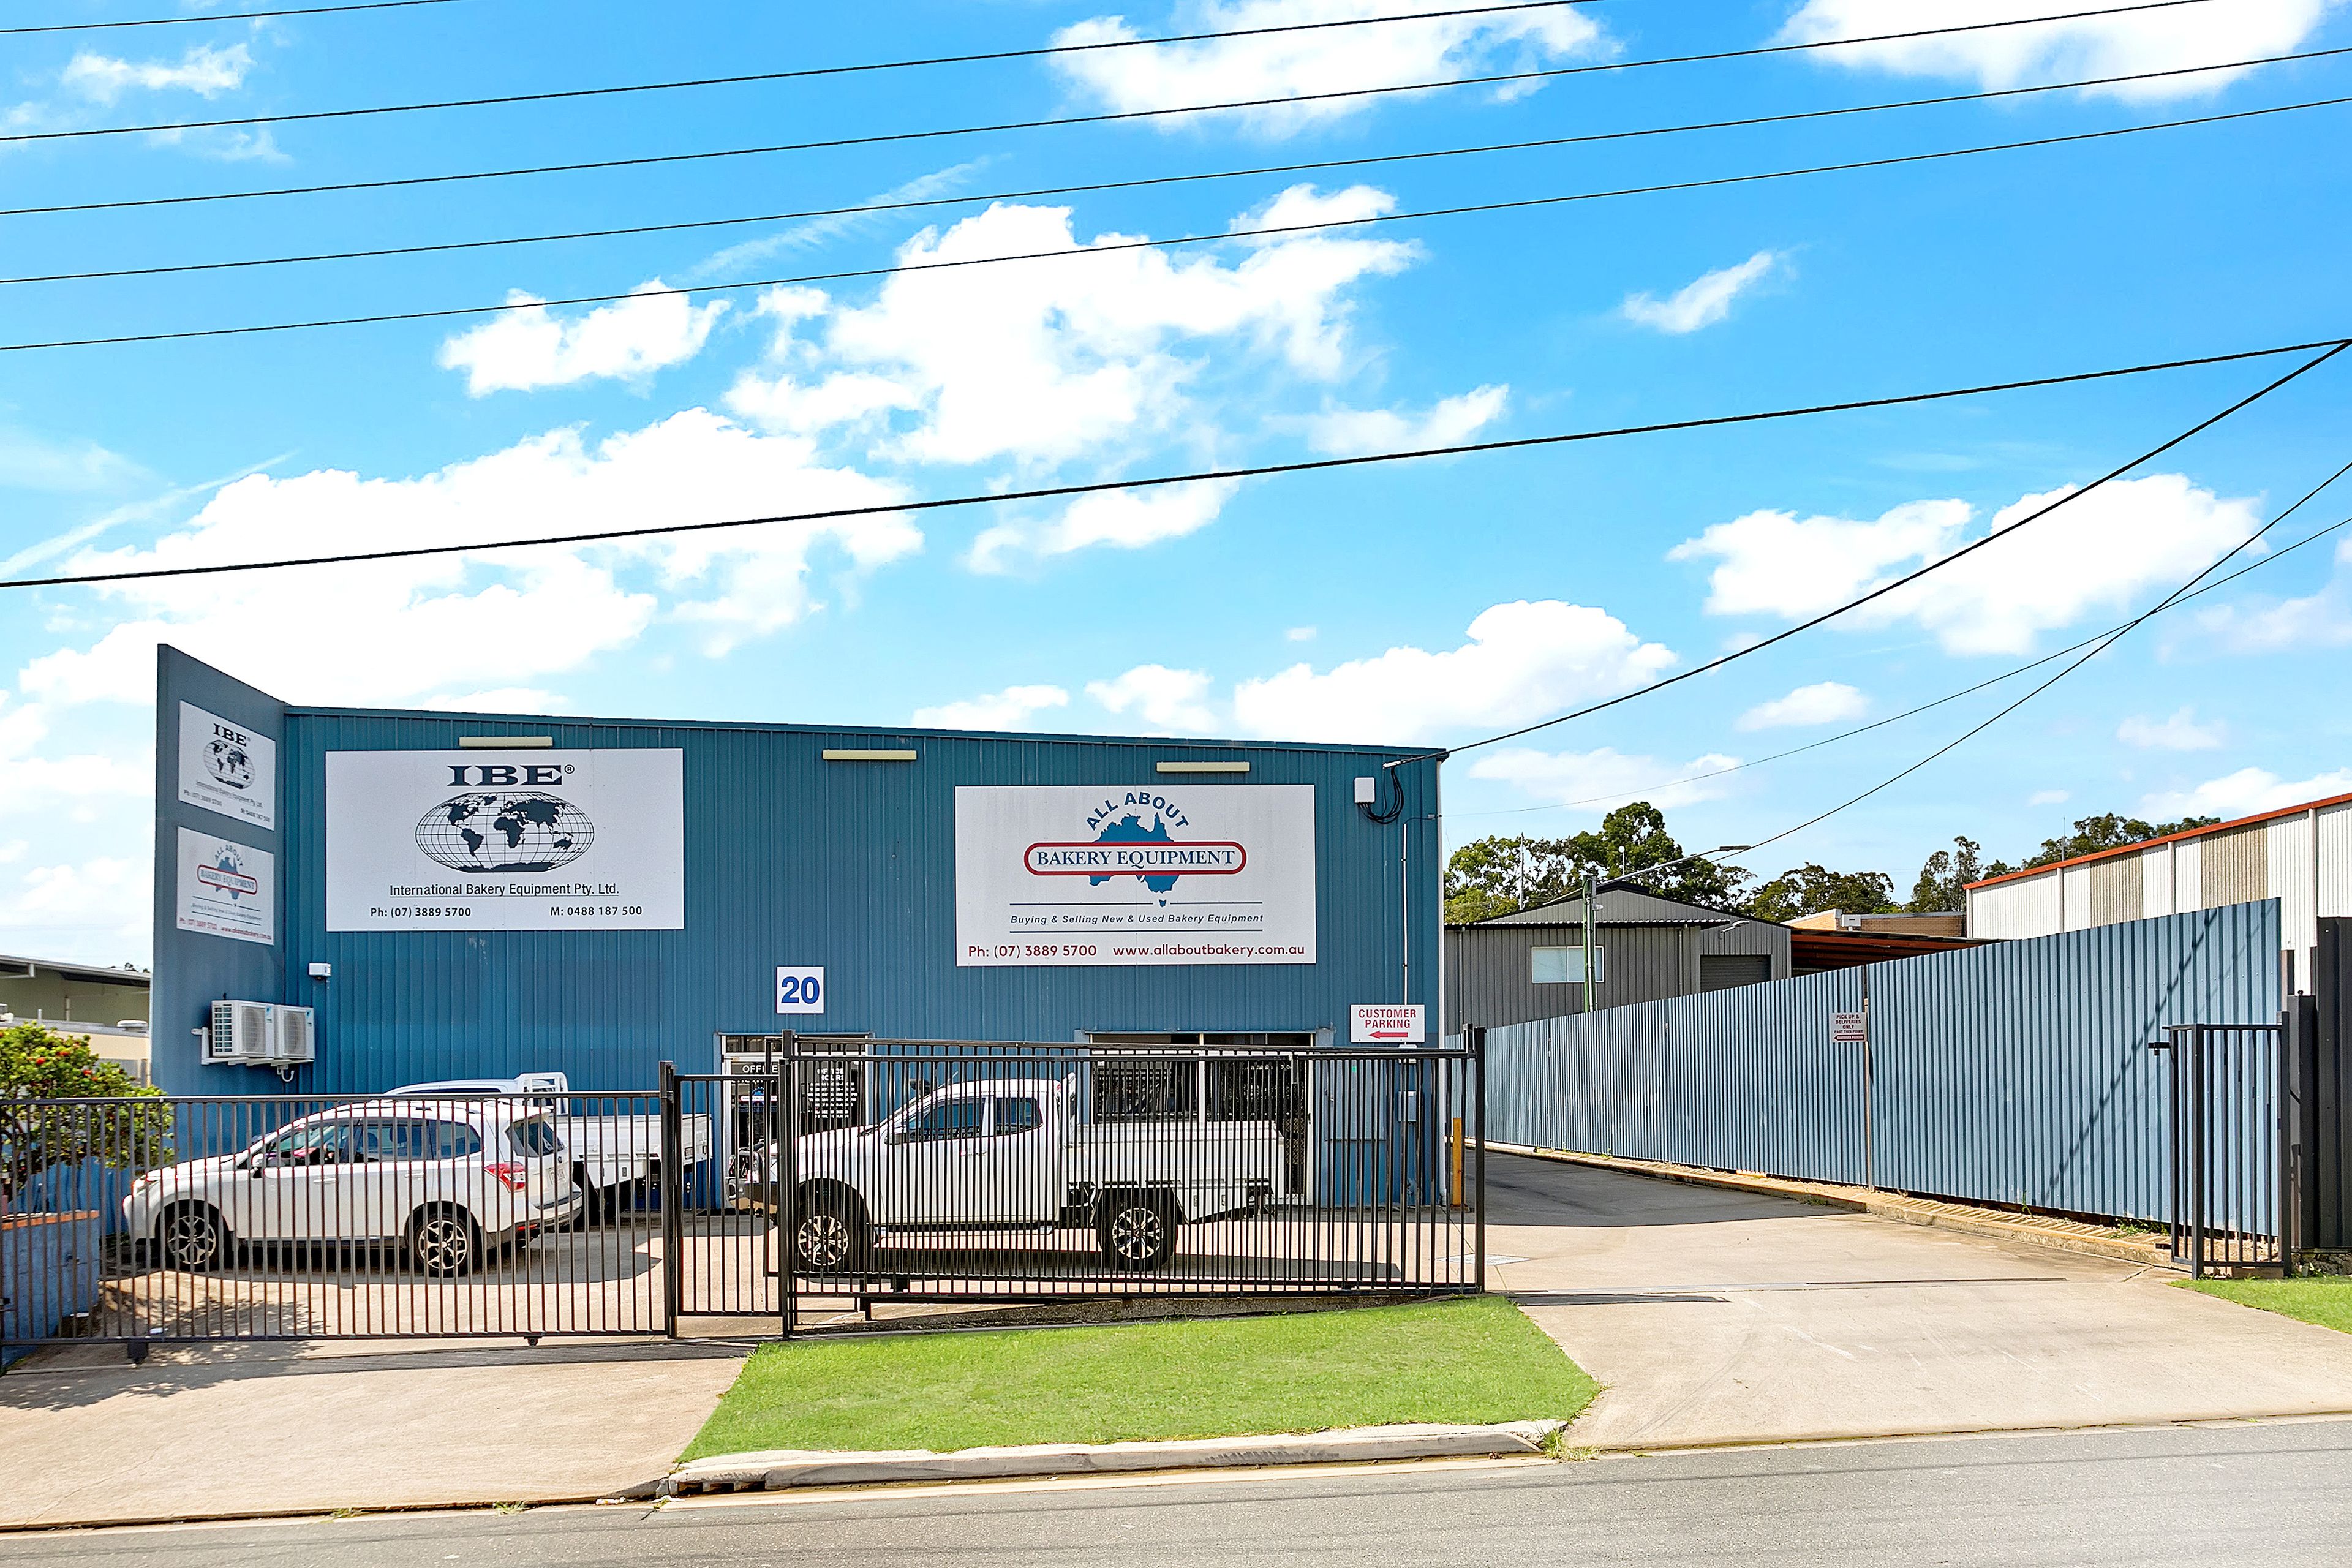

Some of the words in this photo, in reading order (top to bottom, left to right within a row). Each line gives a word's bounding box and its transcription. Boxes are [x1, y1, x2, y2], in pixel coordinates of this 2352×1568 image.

[1086, 799, 1118, 831] ALL
[1124, 791, 1189, 829] ABOUT
[1036, 850, 1112, 865] BAKERY
[1117, 850, 1235, 869] EQUIPMENT
[390, 883, 462, 896] International
[466, 883, 505, 897] Bakery
[509, 883, 571, 896] Equipment
[574, 883, 595, 896] Pty.
[598, 883, 619, 894] Ltd.
[371, 907, 388, 917] Ph:
[390, 907, 412, 918] (07)
[415, 907, 442, 917] 3889
[445, 907, 471, 917] 5700
[550, 907, 564, 916] M:
[567, 906, 595, 916] 0488
[598, 906, 618, 916] 187
[622, 906, 643, 916] 500
[1010, 915, 1047, 925] Buying
[1062, 914, 1098, 925] Selling
[1168, 914, 1204, 924] Bakery
[1207, 914, 1264, 924] Equipment
[968, 946, 989, 957] Ph:
[993, 944, 1020, 959] (07)
[1025, 945, 1058, 957] 3889
[1063, 944, 1097, 957] 5700
[1113, 944, 1305, 957] www.allaboutbakery.com.au
[781, 976, 820, 1004] 20
[1359, 1009, 1417, 1018] CUSTOMER
[1365, 1019, 1411, 1028] PARKING
[742, 1065, 778, 1073] OFFIE
